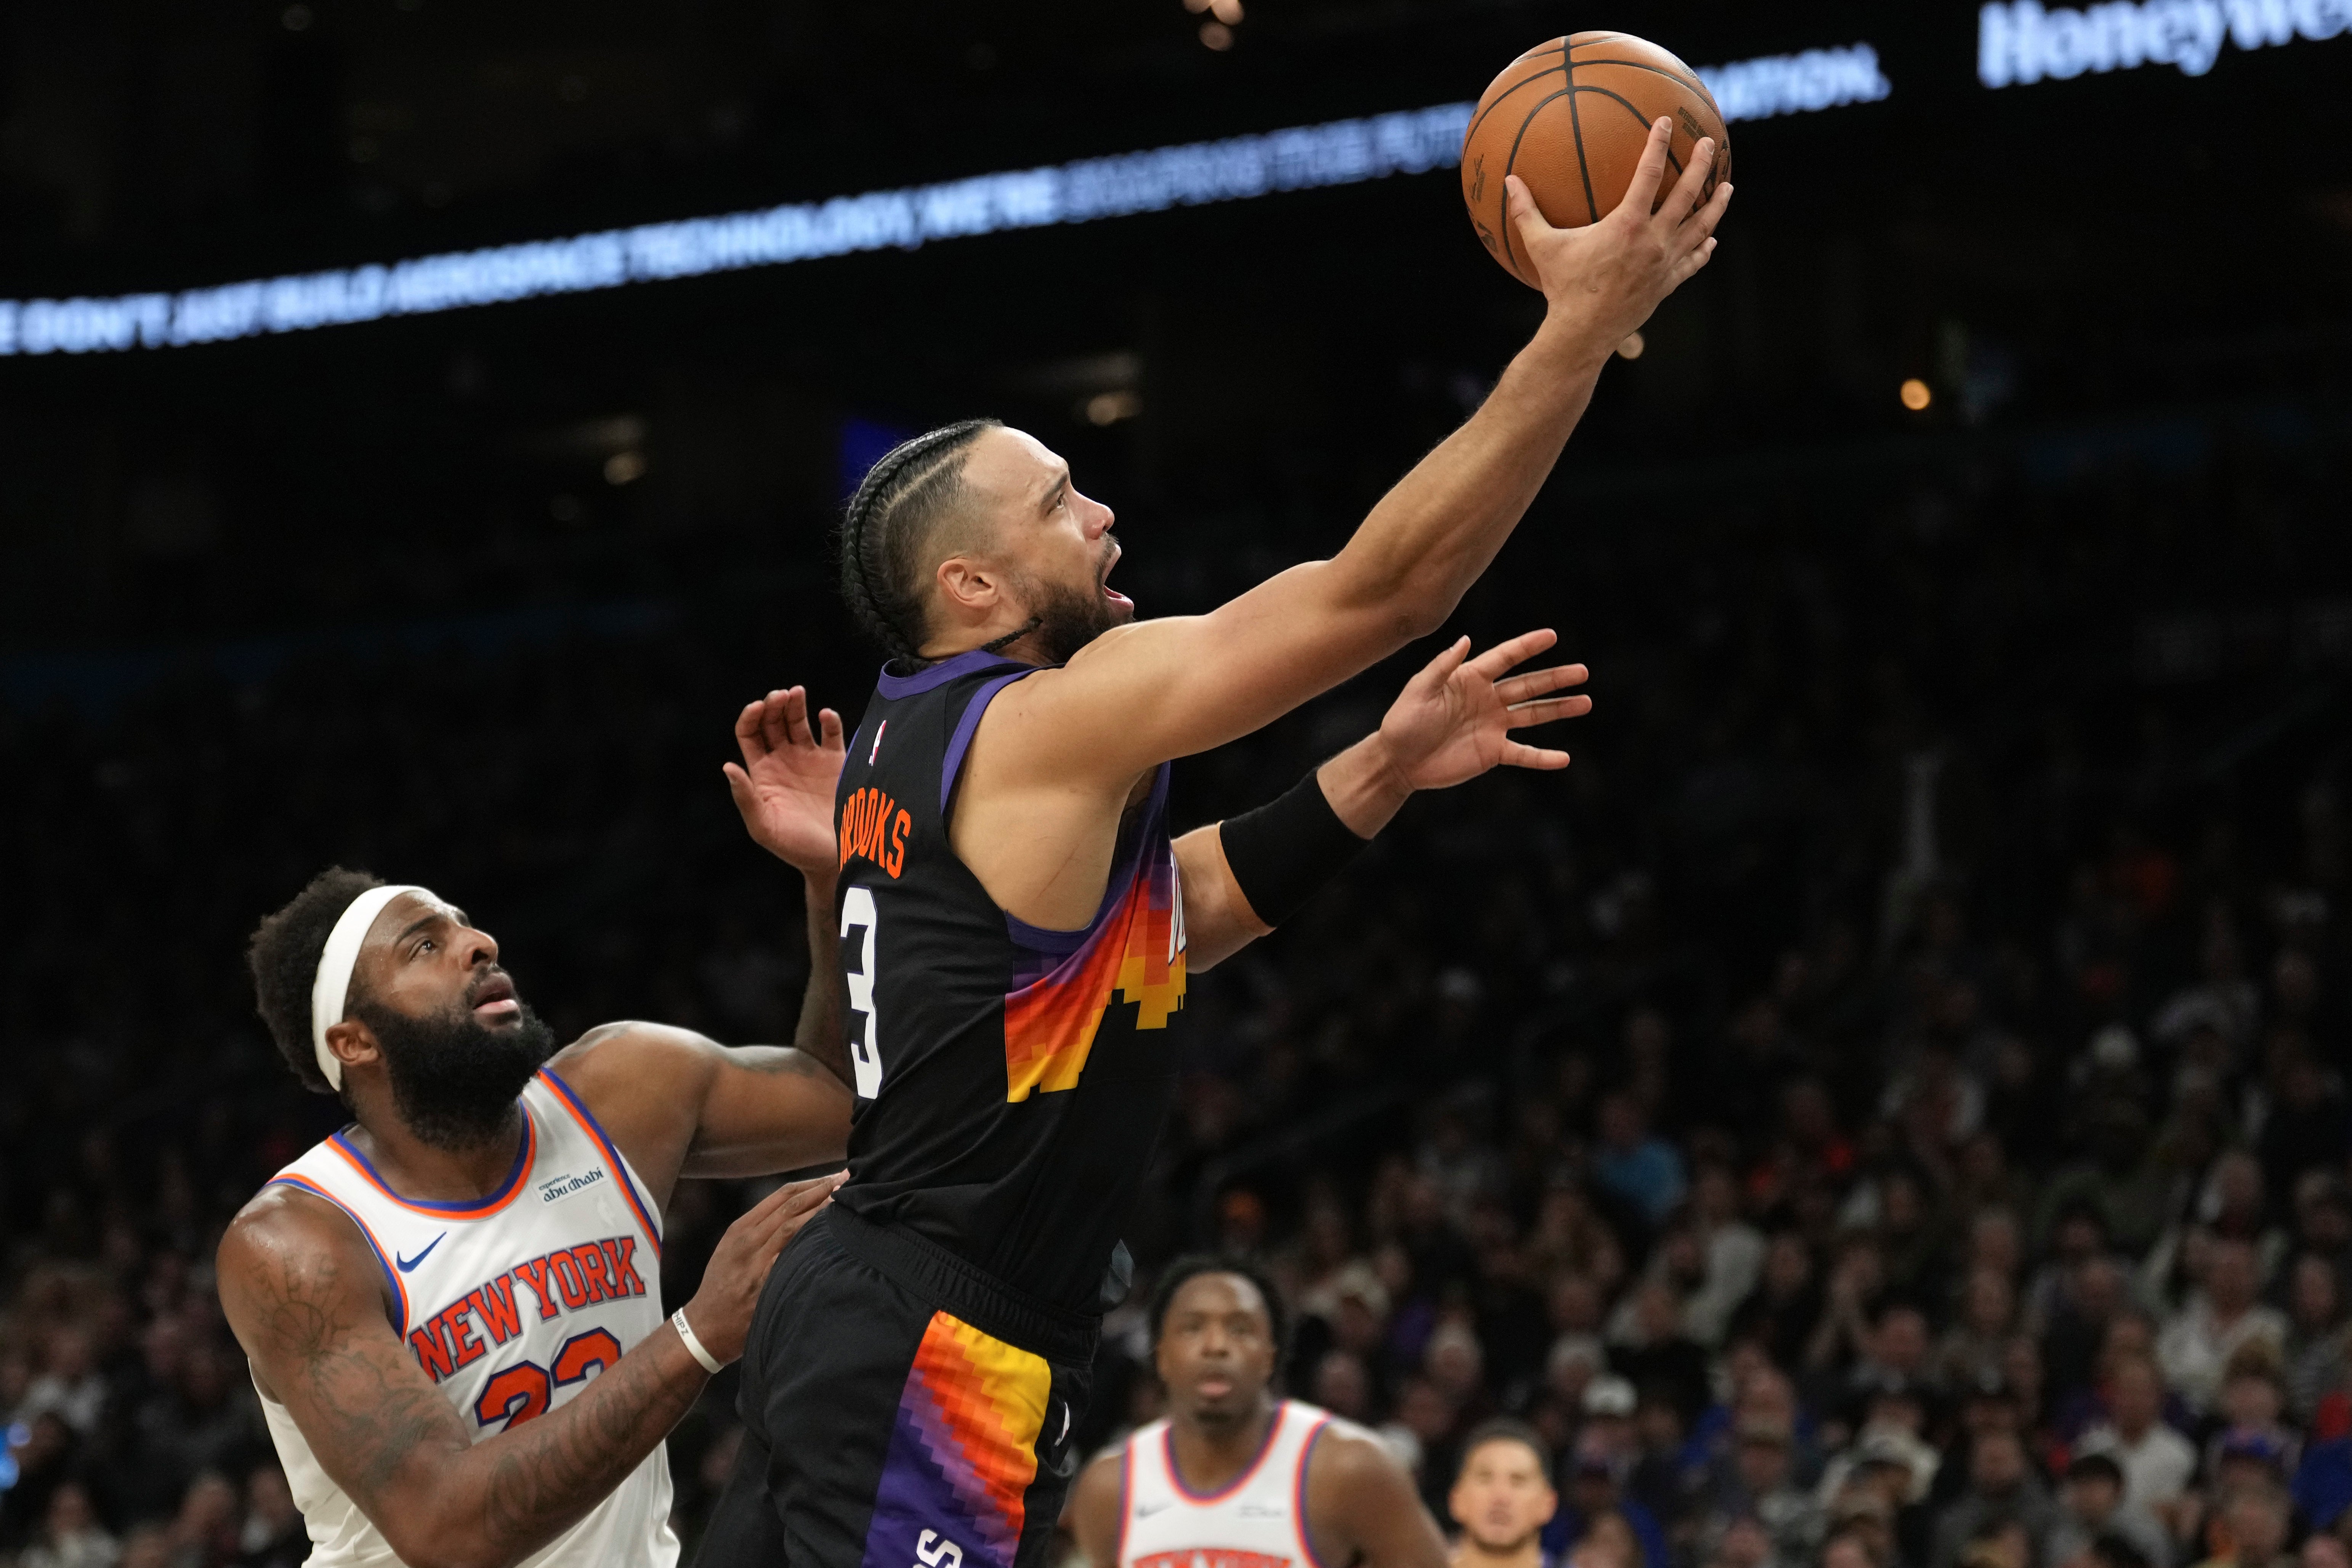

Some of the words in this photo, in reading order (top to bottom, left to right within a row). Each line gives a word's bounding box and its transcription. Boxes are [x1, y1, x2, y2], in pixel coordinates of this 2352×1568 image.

[1978, 0, 2352, 88] Honeywe
[21, 293, 170, 354] DON'T
[268, 265, 389, 332] BUILD
[390, 230, 627, 314] AEROSPACE
[840, 885, 883, 1100] 3
[539, 1174, 571, 1190] experience
[544, 1185, 568, 1202] abu
[409, 1270, 524, 1384] NEW
[513, 1235, 647, 1324] YORK
